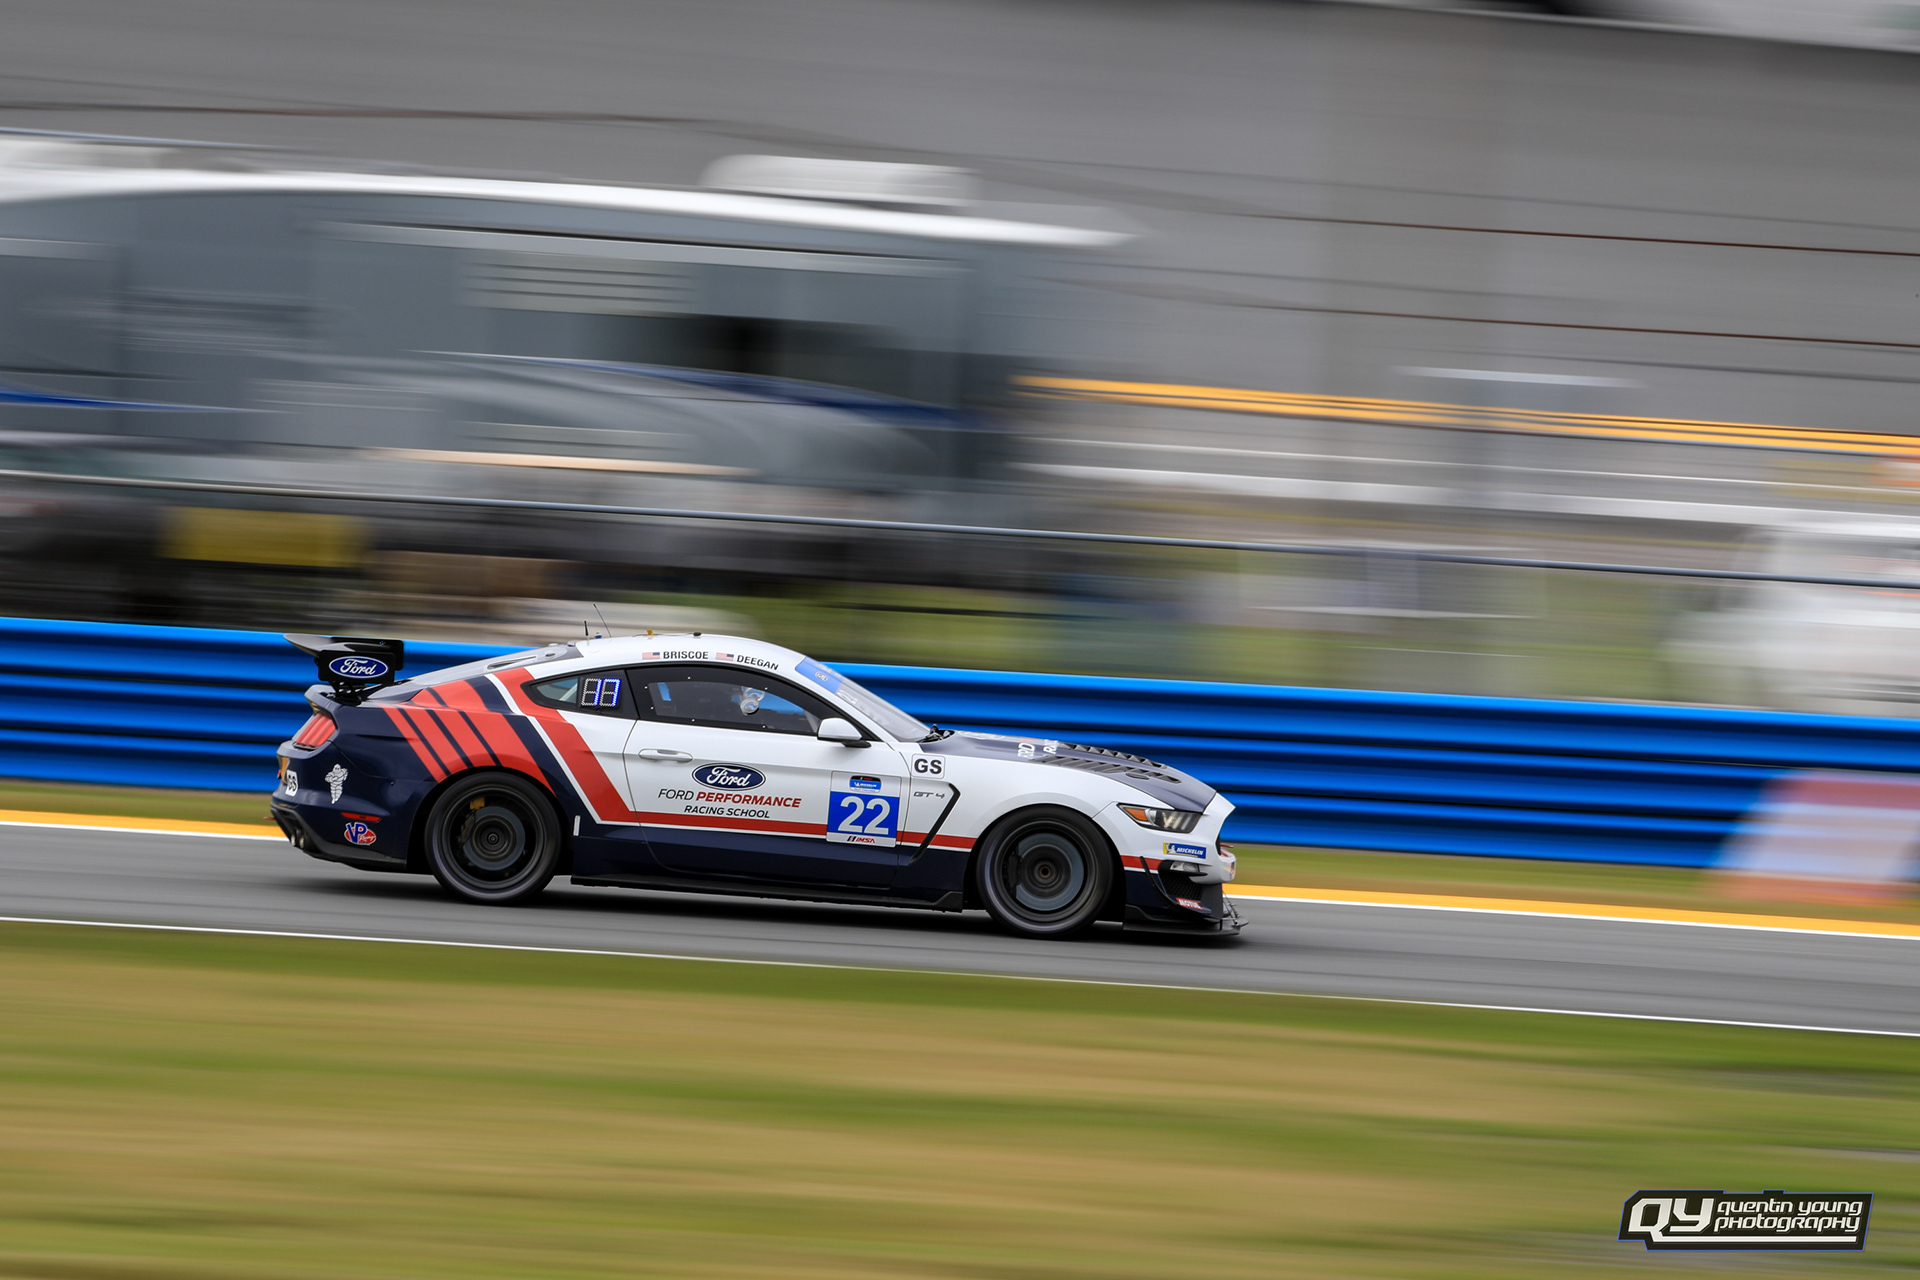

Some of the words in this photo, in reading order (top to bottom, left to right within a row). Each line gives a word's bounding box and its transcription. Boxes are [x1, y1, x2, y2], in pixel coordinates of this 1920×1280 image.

[663, 651, 709, 660] BRISCOE
[737, 654, 779, 671] DEEGAN
[340, 658, 378, 675] Ford
[914, 758, 943, 775] GS
[706, 766, 751, 787] Ford
[657, 788, 694, 801] FORD
[695, 791, 802, 808] PERFORMANCE
[684, 805, 724, 816] RACING
[726, 808, 770, 819] SCHOOL
[837, 795, 891, 836] 22
[345, 822, 367, 844] VP
[1176, 846, 1204, 856] MICHELIN
